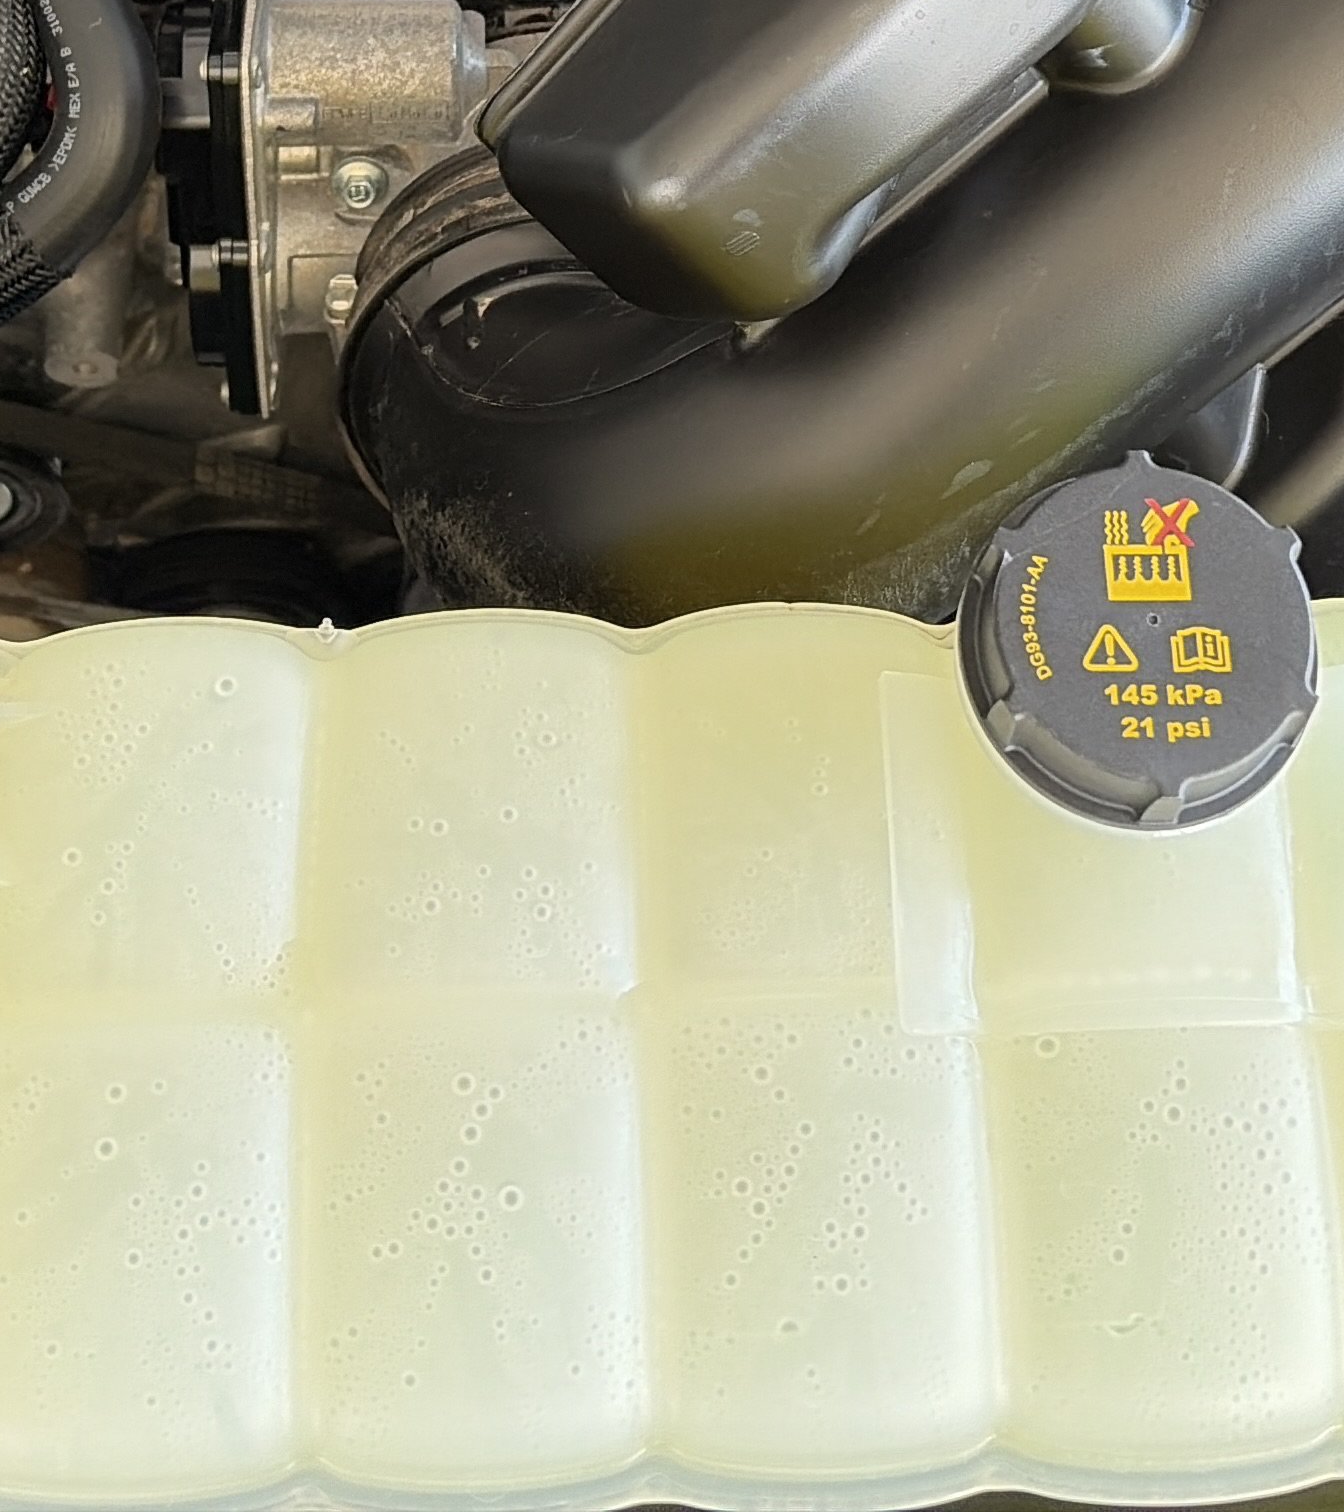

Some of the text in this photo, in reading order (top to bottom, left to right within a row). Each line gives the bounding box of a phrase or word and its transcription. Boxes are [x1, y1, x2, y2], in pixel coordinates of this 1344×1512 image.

[68, 93, 81, 118] MEX
[1017, 554, 1054, 681] DG93-8101-AA
[1103, 683, 1223, 707] 145 kPa
[1120, 716, 1212, 743] 21 psi
